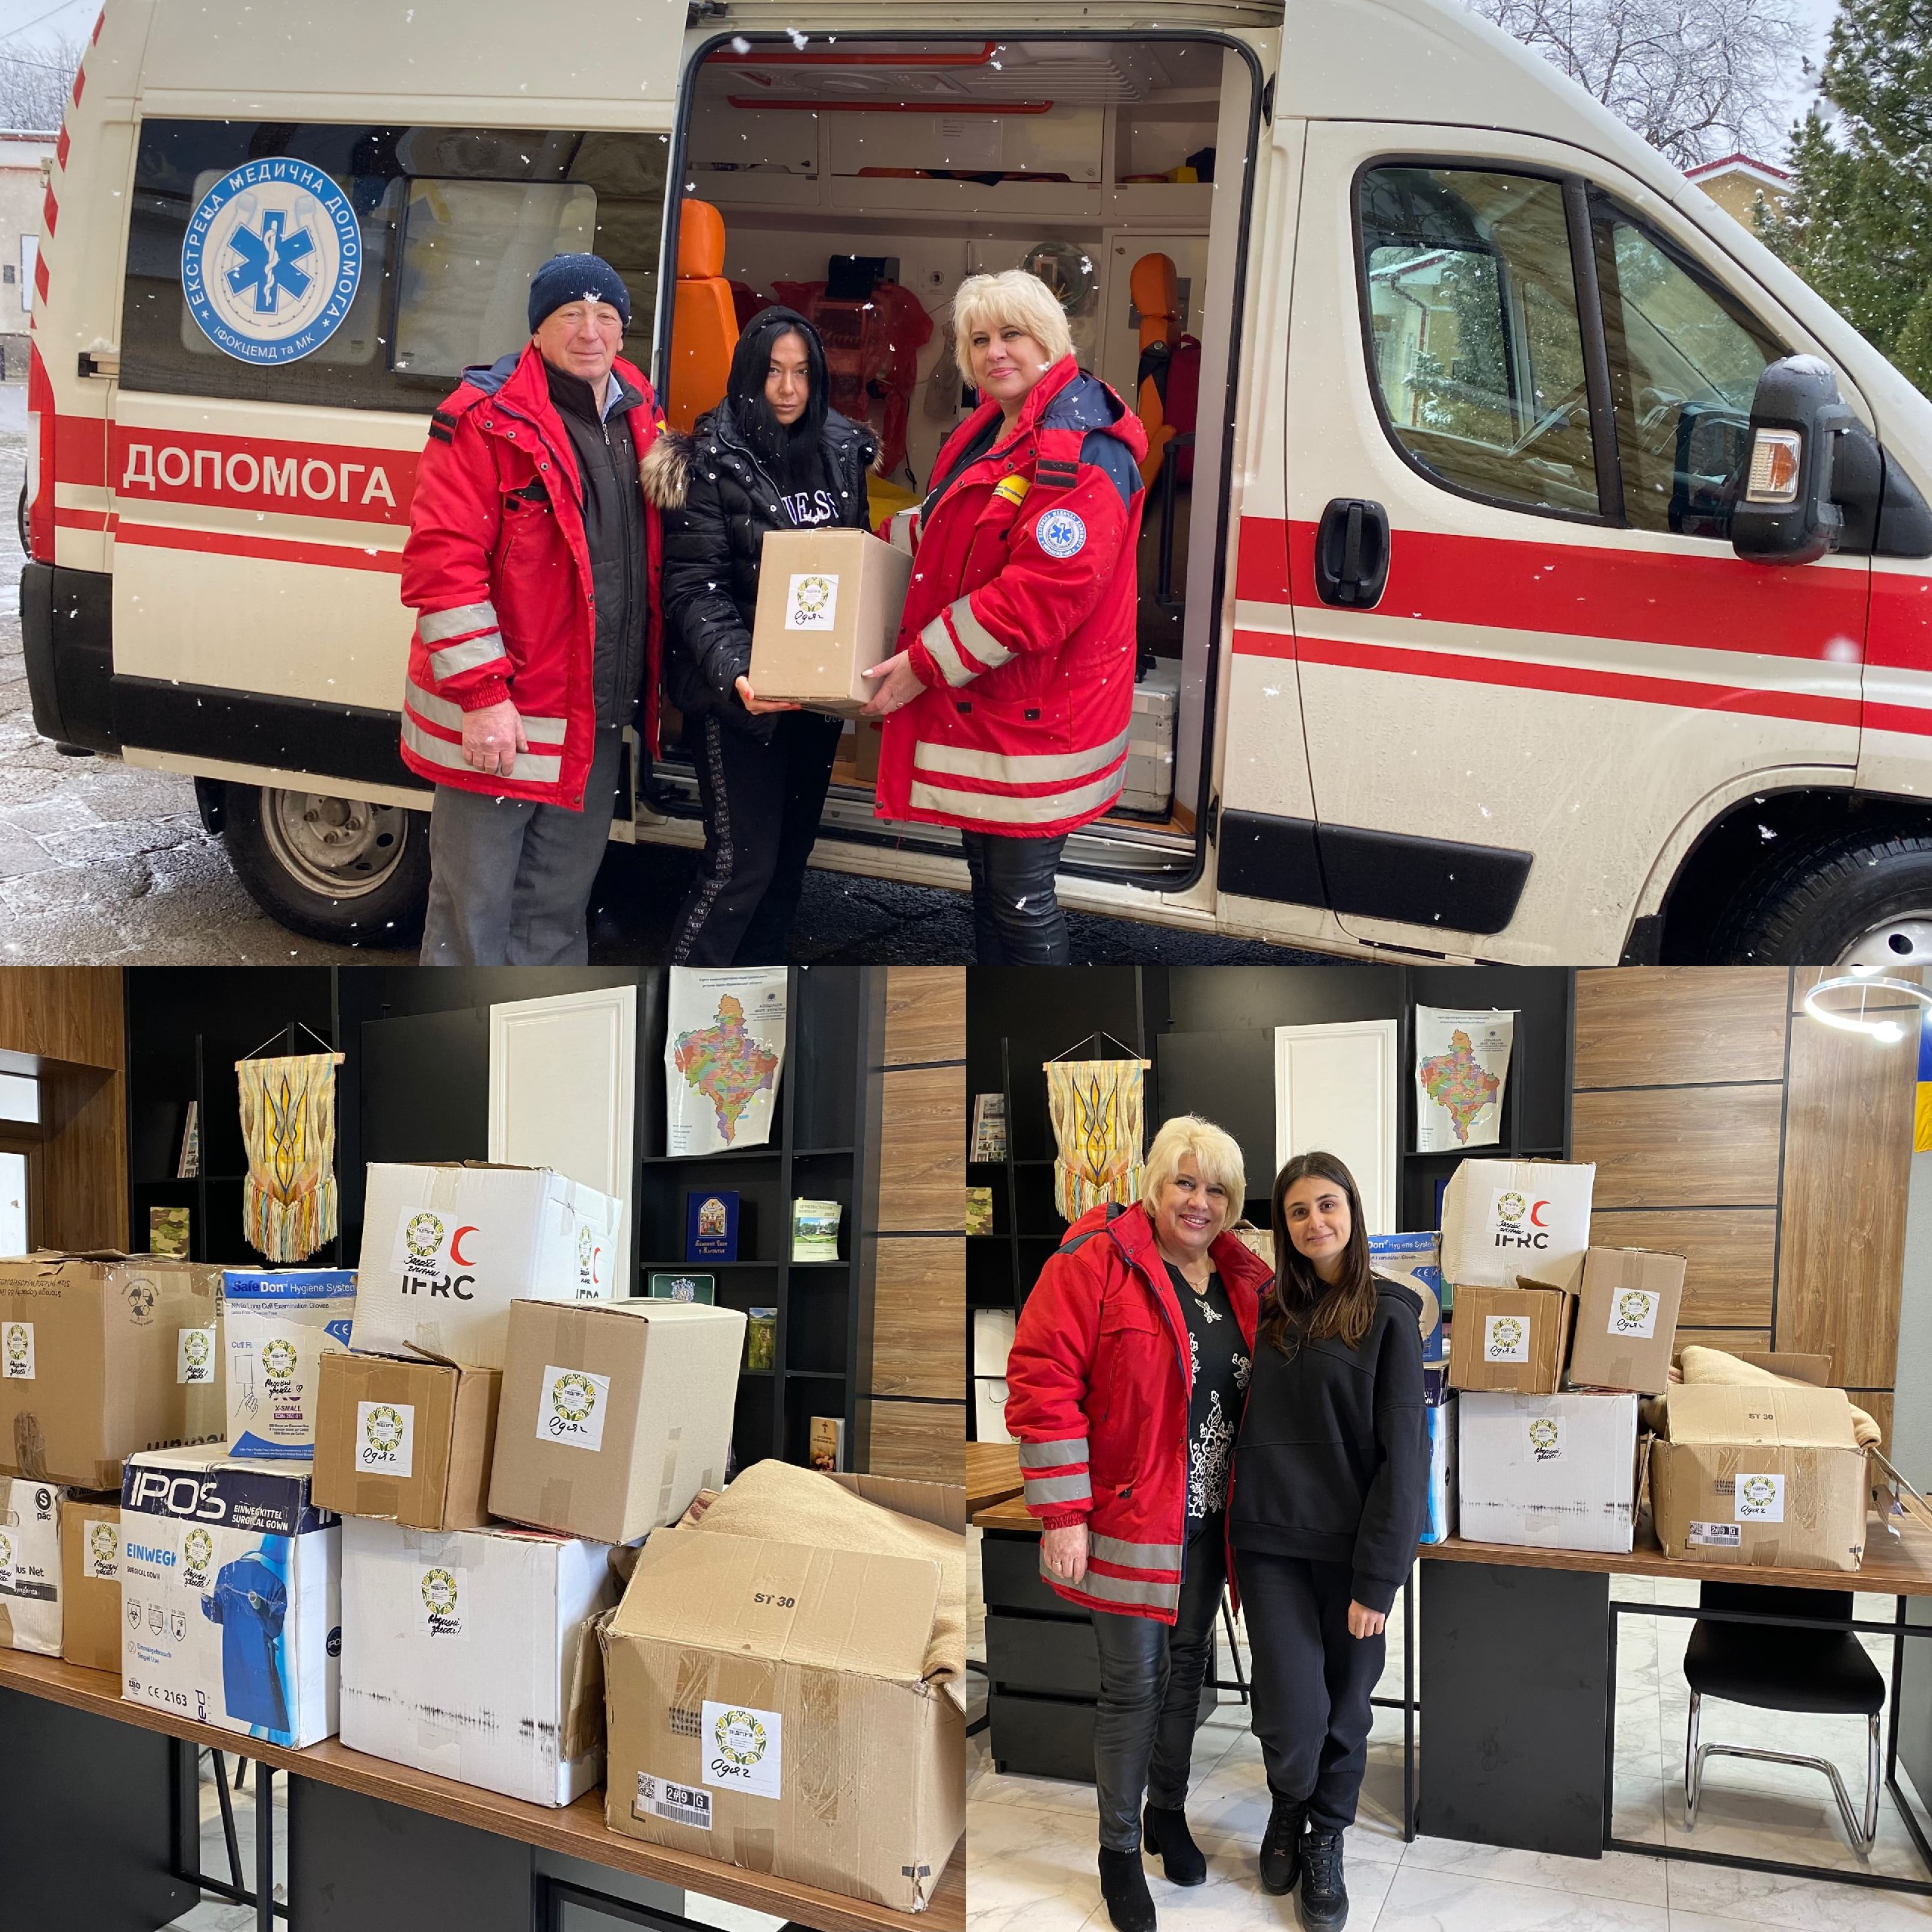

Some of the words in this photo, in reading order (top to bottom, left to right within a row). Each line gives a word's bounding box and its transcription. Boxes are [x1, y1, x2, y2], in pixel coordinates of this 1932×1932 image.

[186, 193, 224, 306] ЕКСТРЕНА
[229, 162, 324, 193] МЕДИЧНА
[325, 196, 357, 318] ДОПОМОГА
[214, 326, 278, 358] ІФОКЦЕМД
[280, 346, 294, 356] та
[296, 332, 315, 350] МК
[122, 443, 396, 509] ДОПОМОГА
[1389, 1241, 1414, 1250] Hygiene
[1495, 1232, 1549, 1250] IFRC
[15, 1287, 38, 1297] Capacity
[38, 1288, 62, 1297] Storage
[290, 1283, 325, 1294] Hygiene
[401, 1274, 475, 1300] IFRC
[362, 1447, 397, 1464] Одяг
[130, 1472, 226, 1519] IPOS
[233, 1504, 283, 1519] EINWEGKITTEL
[1740, 1505, 1766, 1516] Одяг
[231, 1514, 265, 1528] SURGICAL
[266, 1518, 288, 1531] GOWN
[29, 1565, 45, 1577] Net
[127, 1565, 146, 1578] SURGICAL
[146, 1569, 161, 1580] GOWN
[754, 1592, 775, 1604] ST
[777, 1596, 795, 1608] 30
[128, 1680, 140, 1690] ISO
[164, 1689, 187, 1706] 2163
[711, 1758, 751, 1777] Одяг
